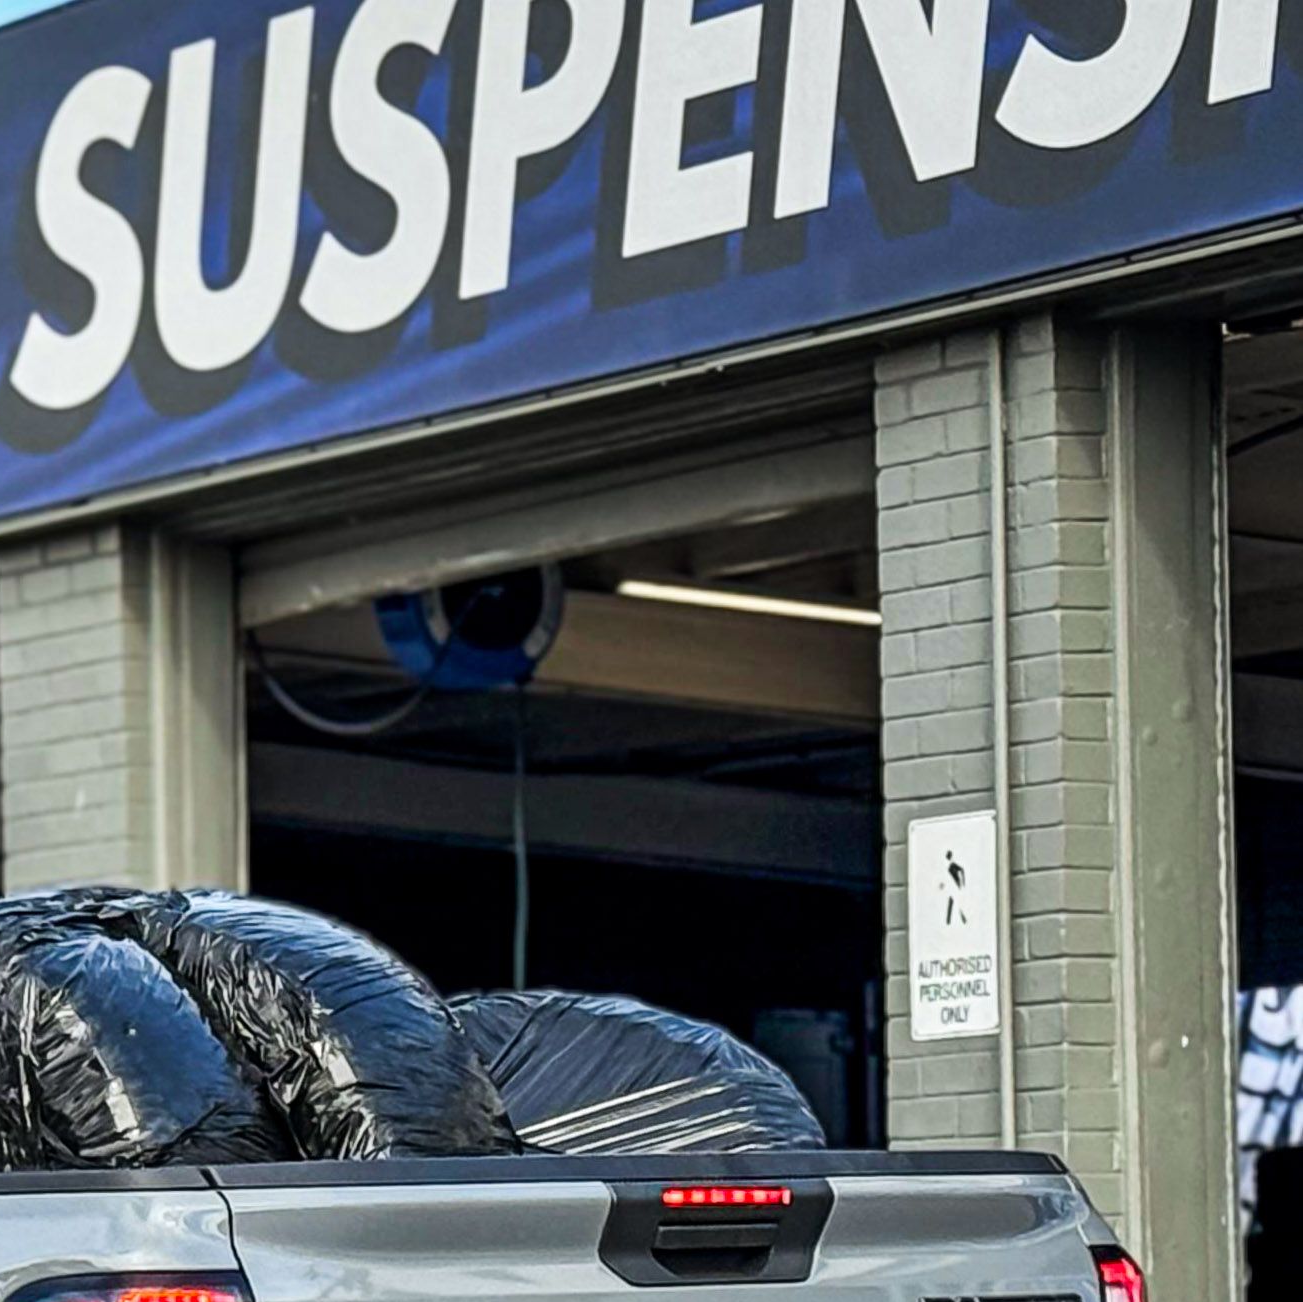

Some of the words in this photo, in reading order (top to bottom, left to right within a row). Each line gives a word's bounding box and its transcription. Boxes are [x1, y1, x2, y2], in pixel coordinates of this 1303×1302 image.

[9, 0, 1280, 410] SUSPEN
[918, 955, 992, 979] AUTHORISED
[919, 979, 990, 1002] PERSONNEL
[941, 1005, 970, 1024] ONLY
